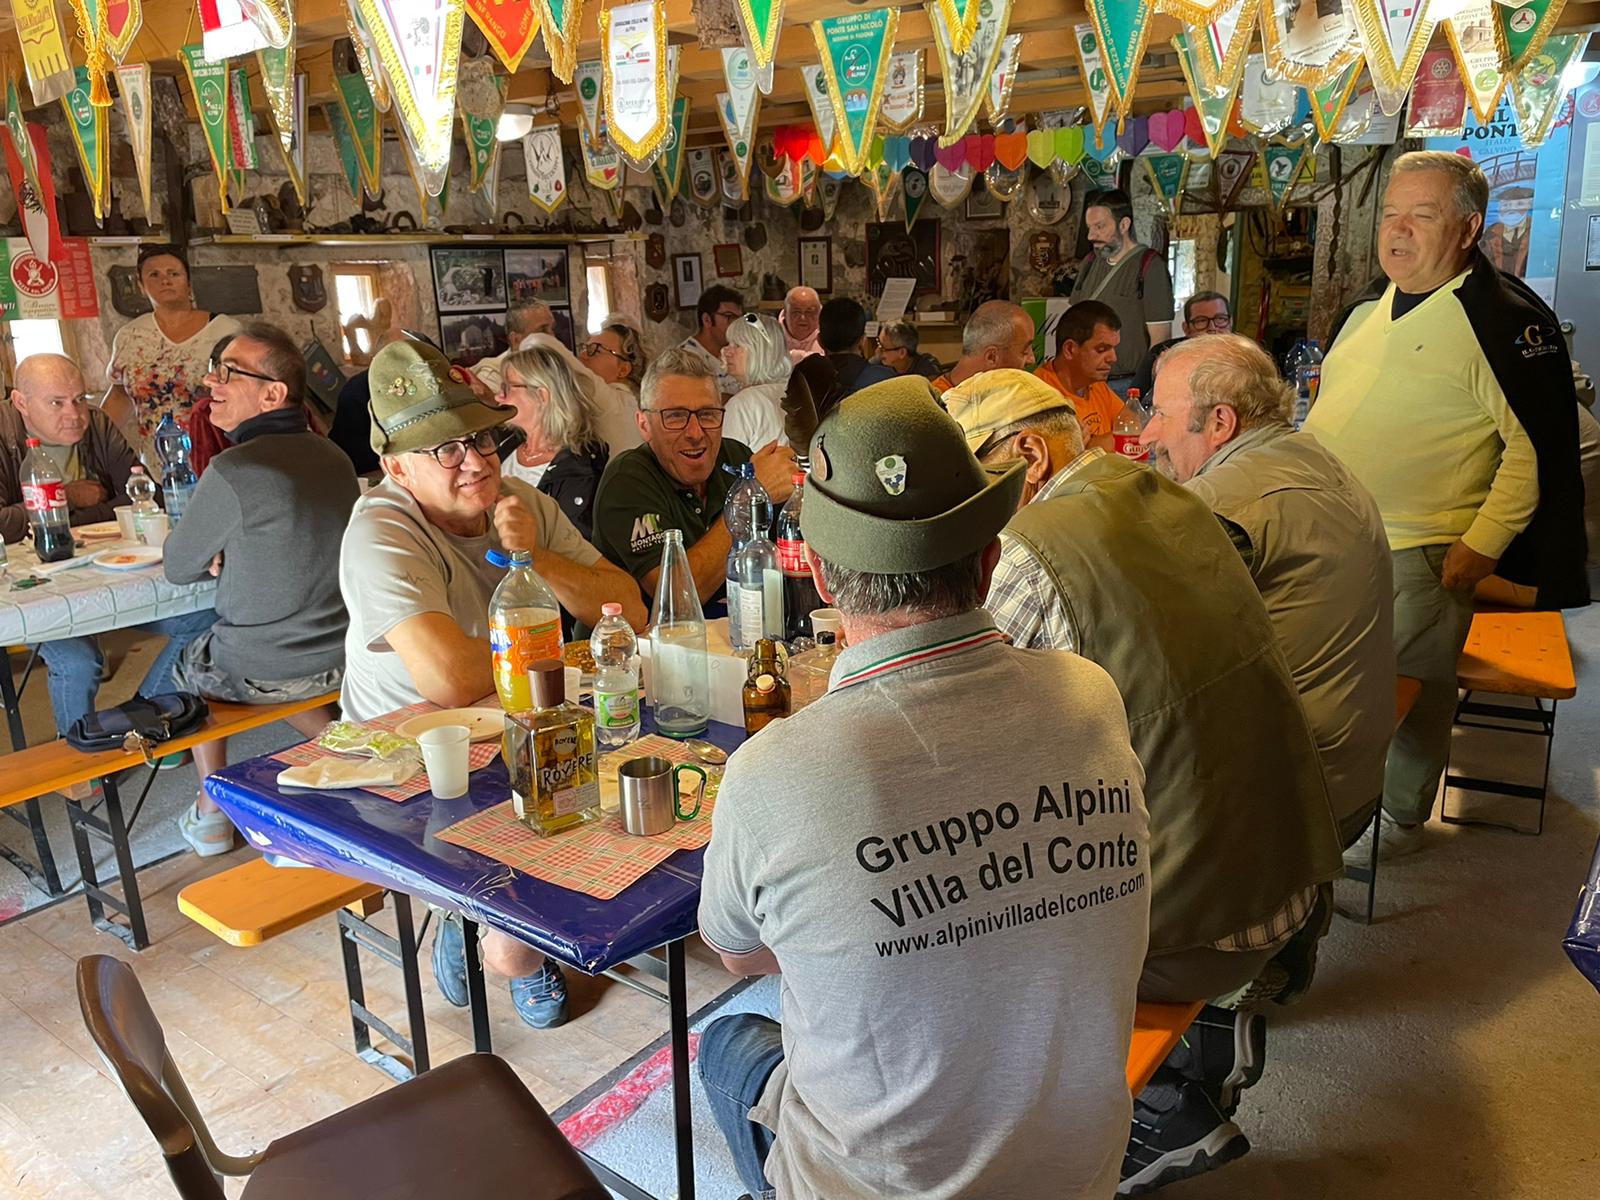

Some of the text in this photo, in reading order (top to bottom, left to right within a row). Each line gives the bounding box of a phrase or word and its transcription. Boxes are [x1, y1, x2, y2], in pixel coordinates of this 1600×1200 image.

[837, 14, 862, 24] GRUPPO
[1136, 0, 1146, 25] ONTE
[827, 26, 846, 35] PONTE
[847, 24, 859, 32] SAN
[1461, 123, 1518, 141] PONT
[543, 752, 593, 785] ROVERE
[855, 778, 1131, 873] Gruppo Alpini
[870, 832, 1138, 928] Villa del Conte
[874, 871, 1146, 957] www.alpinivilladelconte.com
